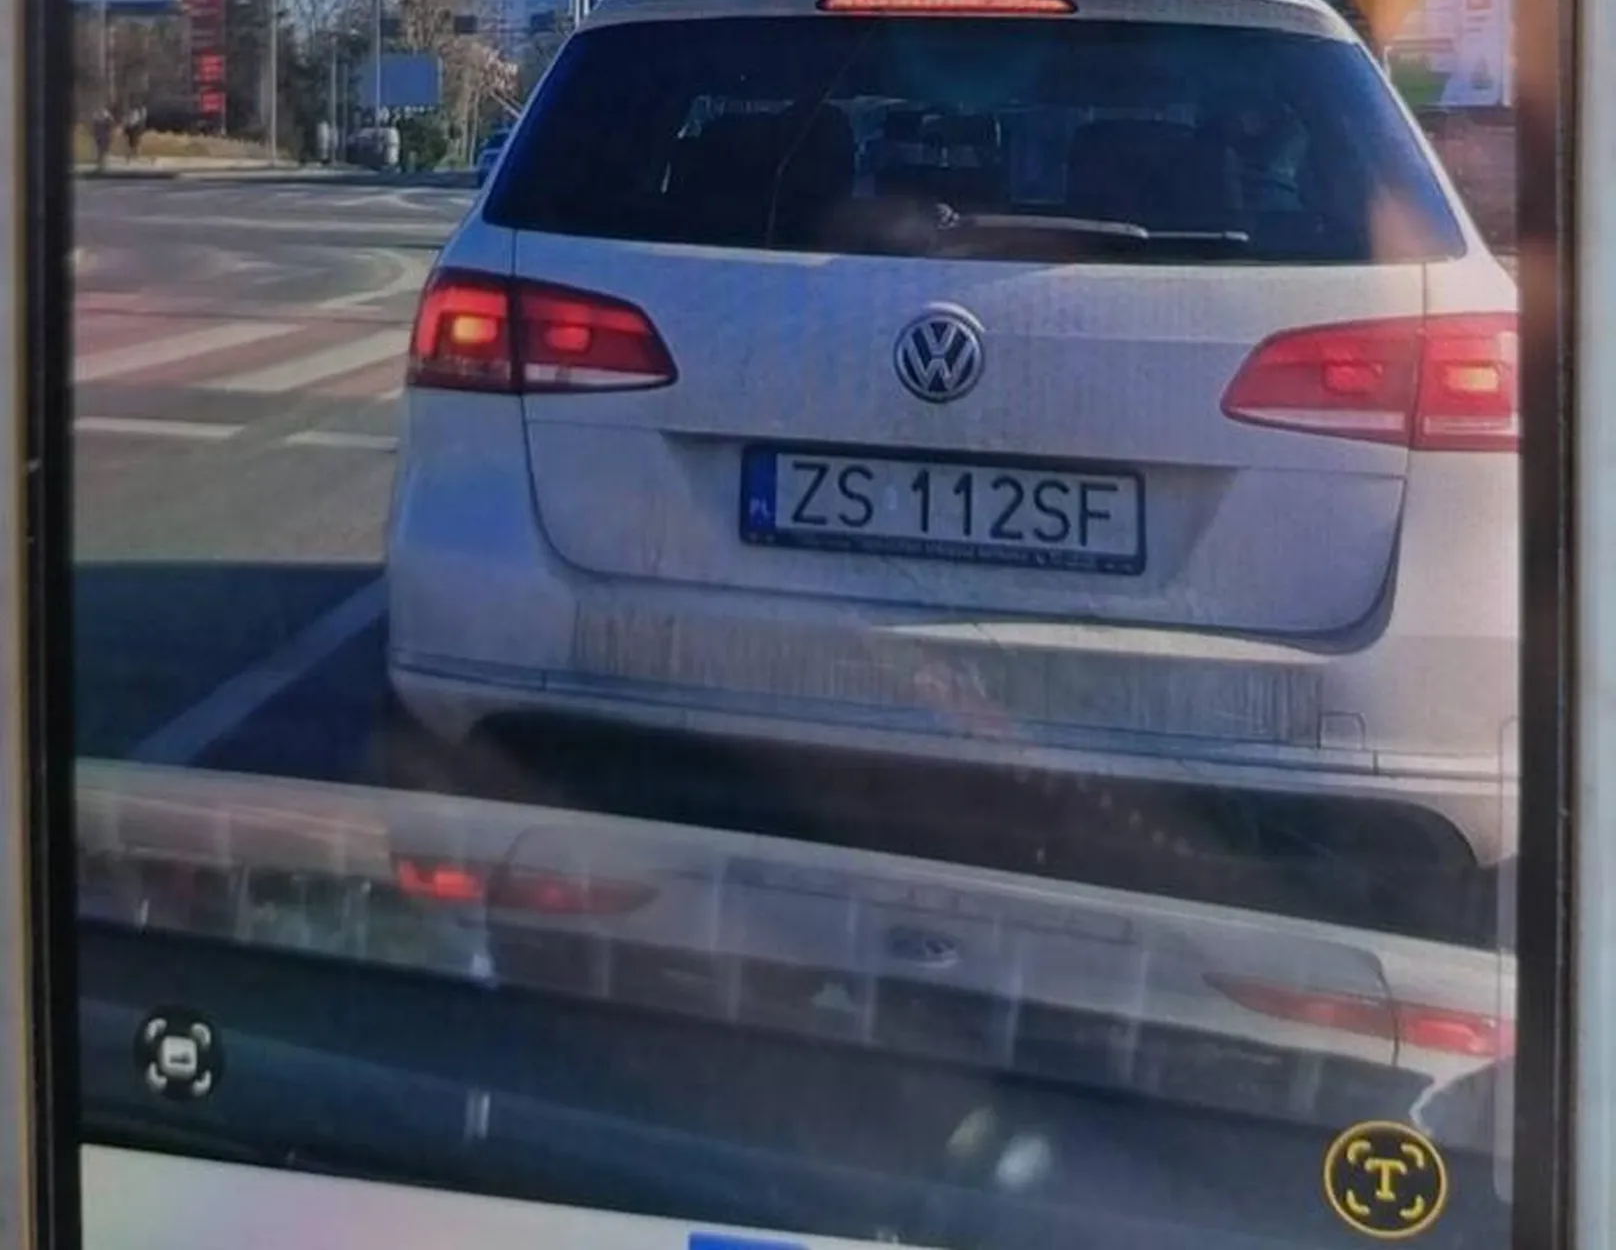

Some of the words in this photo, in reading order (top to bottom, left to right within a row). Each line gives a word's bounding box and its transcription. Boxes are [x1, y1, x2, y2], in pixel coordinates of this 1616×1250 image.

[895, 310, 983, 400] VW
[791, 461, 875, 528] ZS
[911, 468, 1119, 547] 112SF
